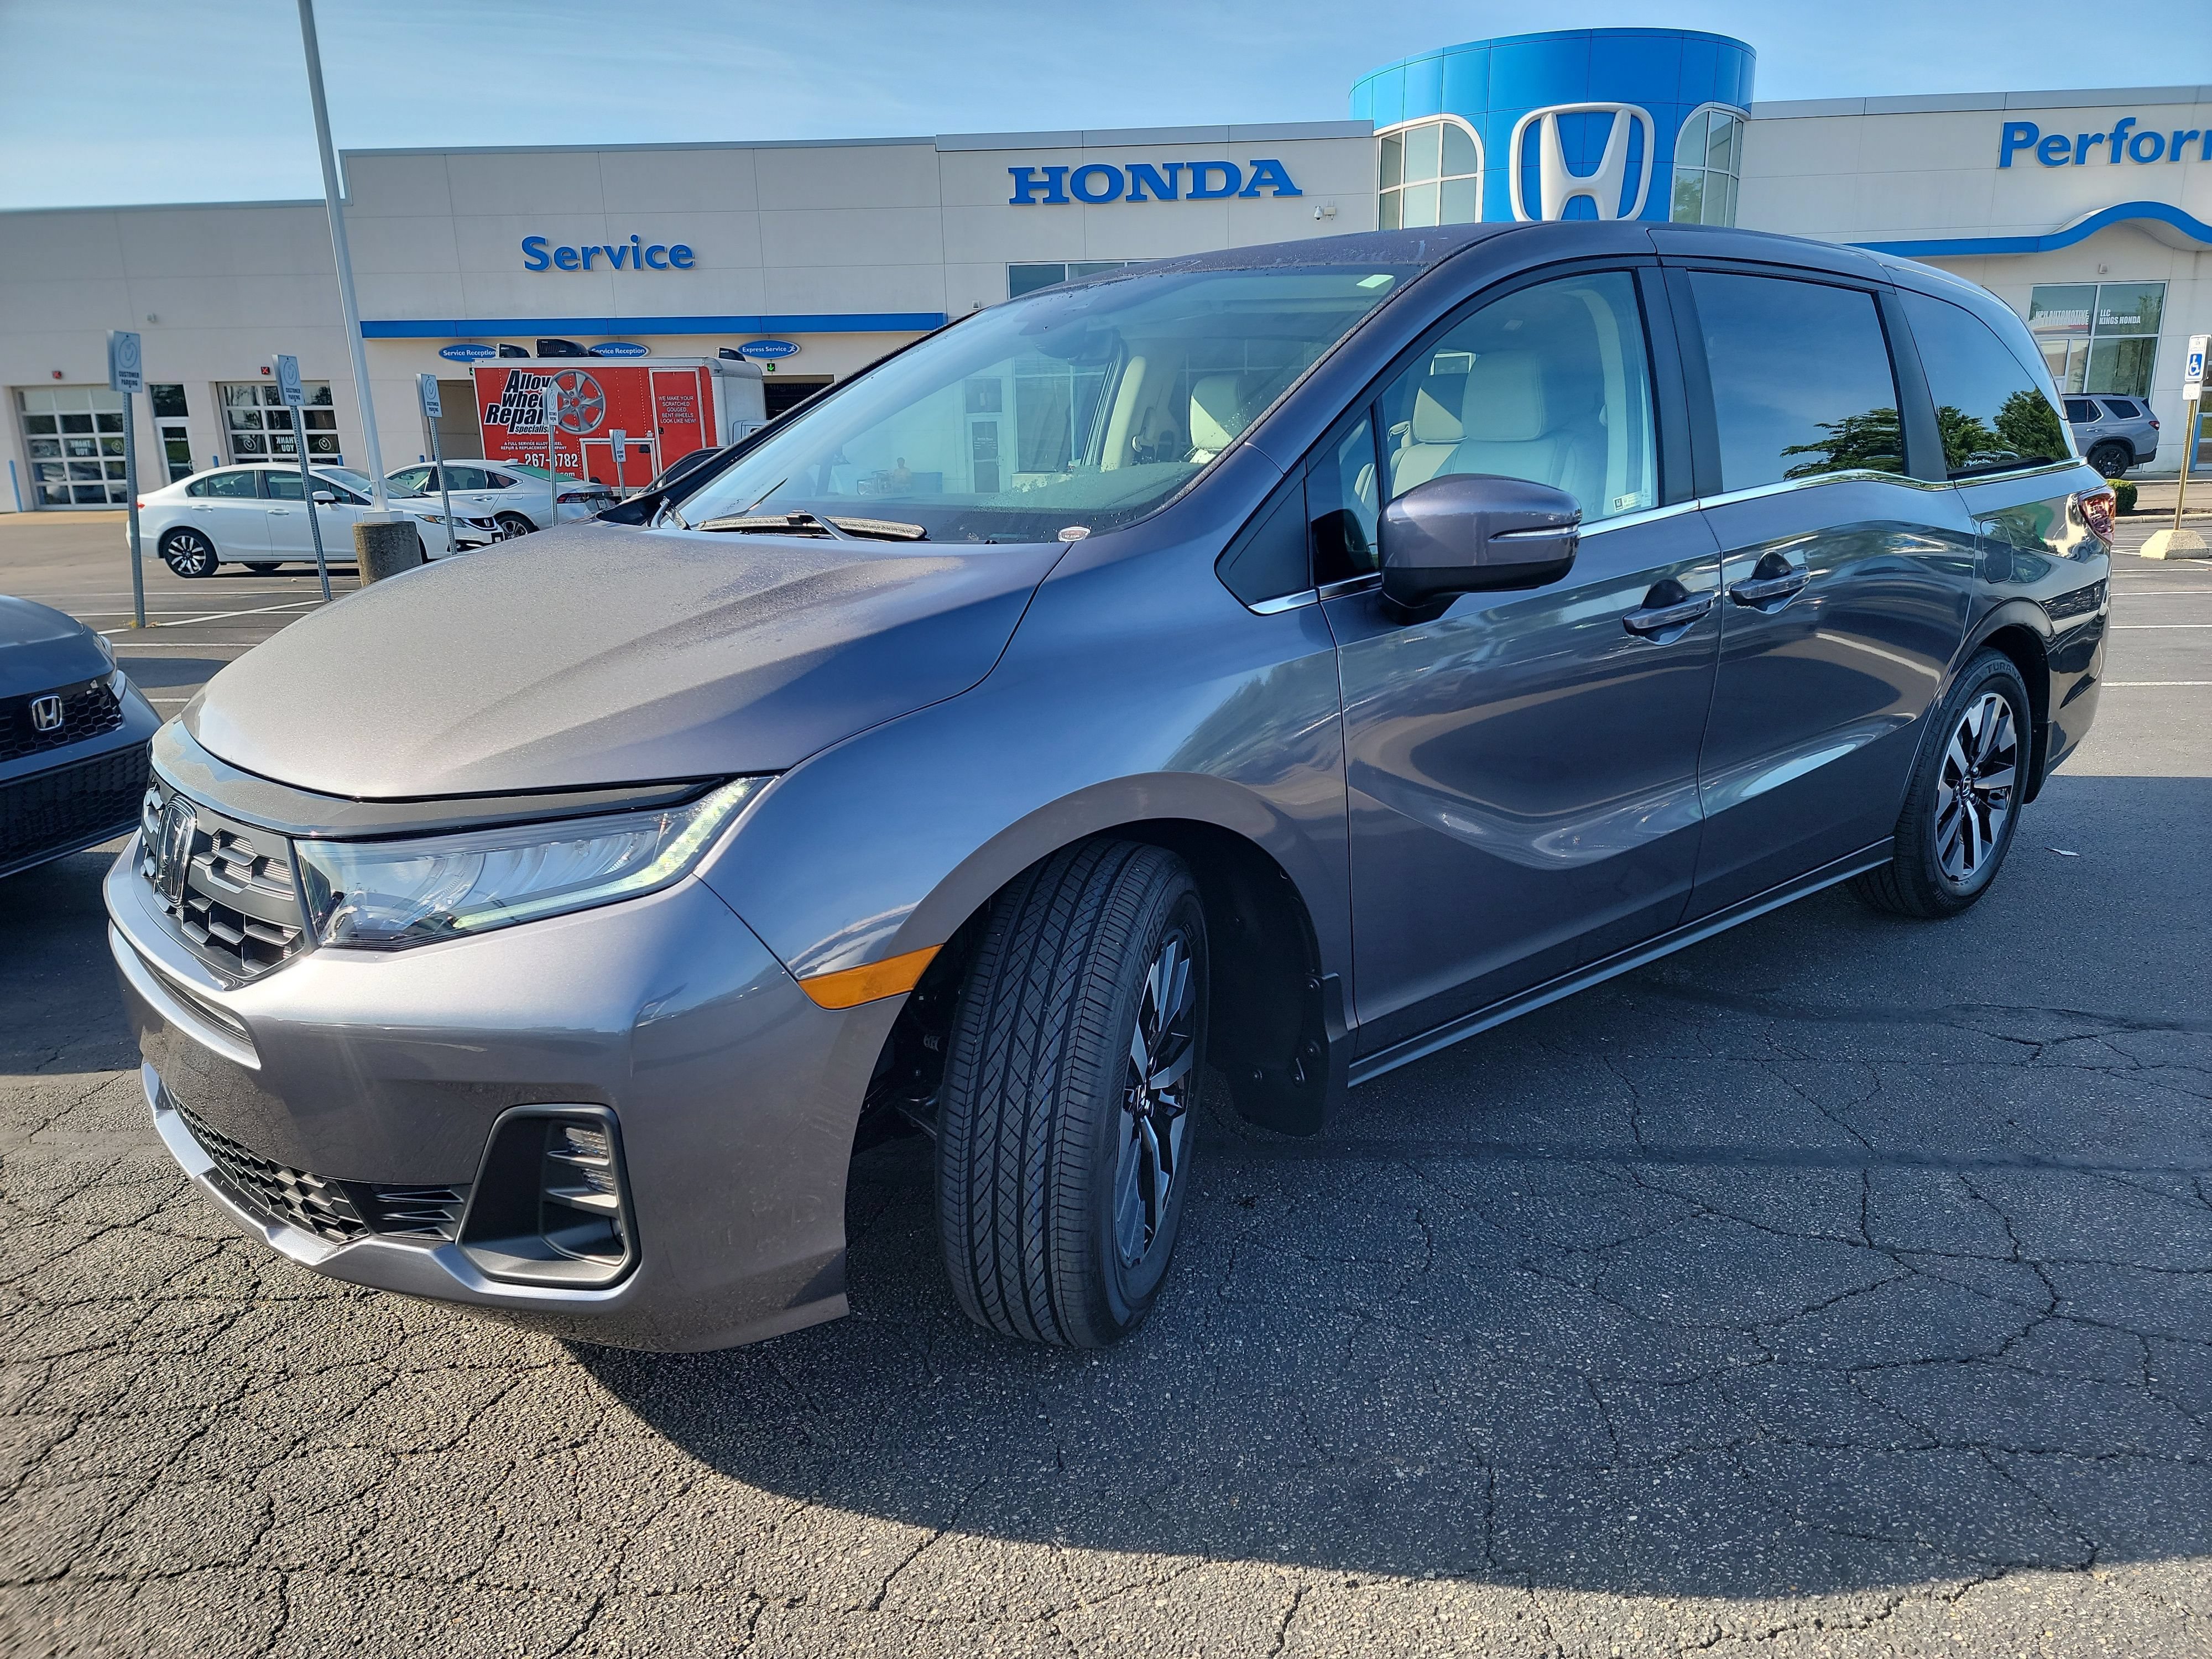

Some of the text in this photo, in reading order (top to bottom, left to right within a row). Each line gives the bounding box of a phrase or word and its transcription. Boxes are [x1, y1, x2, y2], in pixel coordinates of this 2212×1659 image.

[1998, 116, 2212, 168] Perfor
[1008, 158, 1303, 205] HONDA
[521, 234, 695, 272] Service
[2099, 316, 2119, 325] KINGS
[2119, 316, 2141, 325] HONDA
[504, 369, 551, 392] Alloy
[502, 391, 543, 408] whe
[484, 404, 544, 432] Repai
[515, 425, 549, 434] specialis
